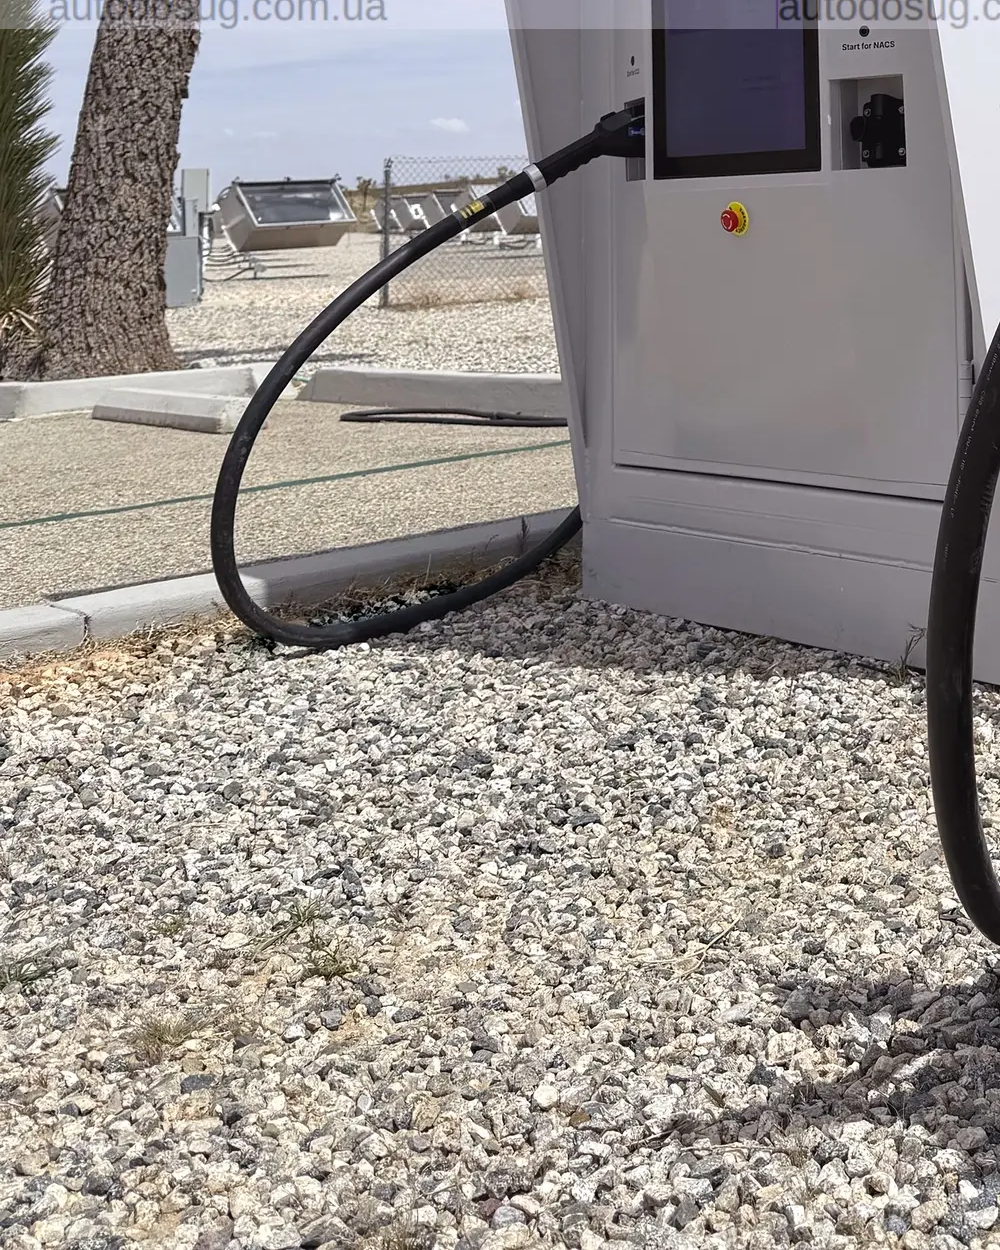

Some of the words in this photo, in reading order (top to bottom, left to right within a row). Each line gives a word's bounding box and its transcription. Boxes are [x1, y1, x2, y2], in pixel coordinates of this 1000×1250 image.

[842, 43, 860, 51] Start
[861, 42, 872, 50] for
[873, 40, 896, 49] NACS
